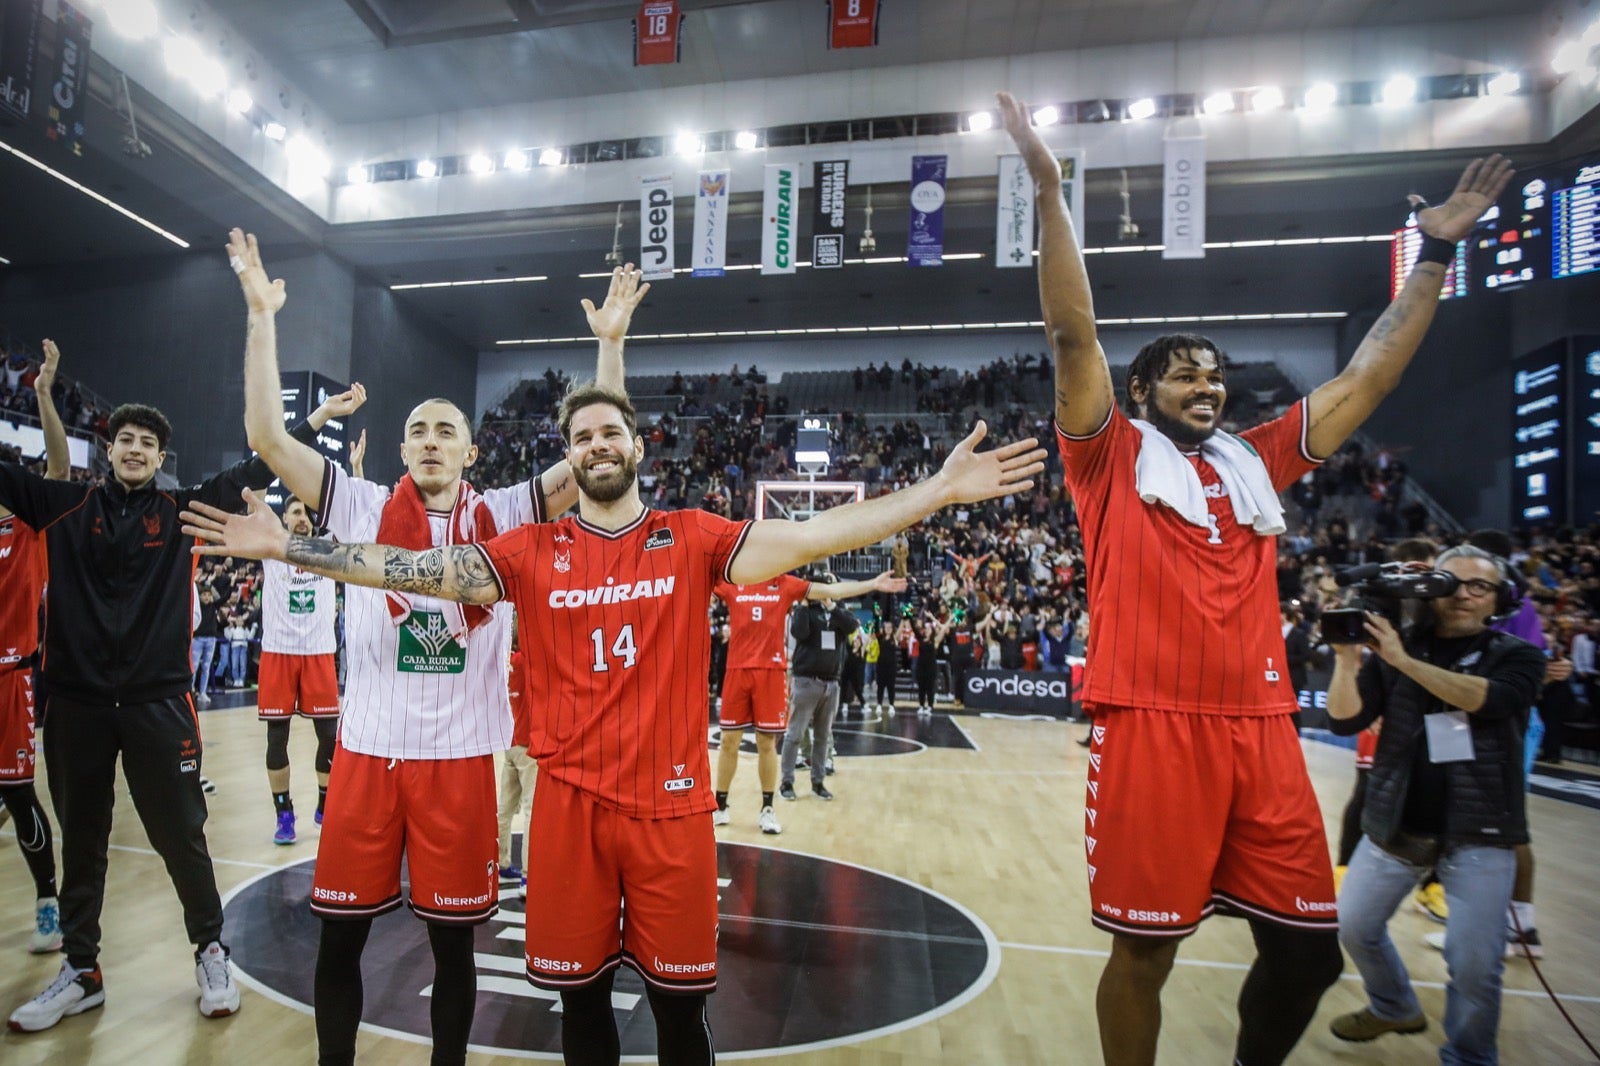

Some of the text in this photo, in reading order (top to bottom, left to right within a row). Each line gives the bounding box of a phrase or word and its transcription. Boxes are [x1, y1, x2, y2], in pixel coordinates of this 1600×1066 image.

[649, 15, 667, 35] 18
[821, 175, 832, 214] VERDAD
[830, 162, 846, 228] BURGERS
[1169, 160, 1191, 236] niobio
[642, 188, 671, 265] Jeep
[752, 606, 763, 621] 9
[591, 623, 637, 672] 14
[402, 655, 461, 666] CAJA RURAL
[414, 664, 449, 672] GRANADA
[968, 674, 1067, 698] endesa
[443, 895, 488, 907] BERNER
[1101, 902, 1169, 922] vive asisa
[665, 962, 715, 973] BERNER
